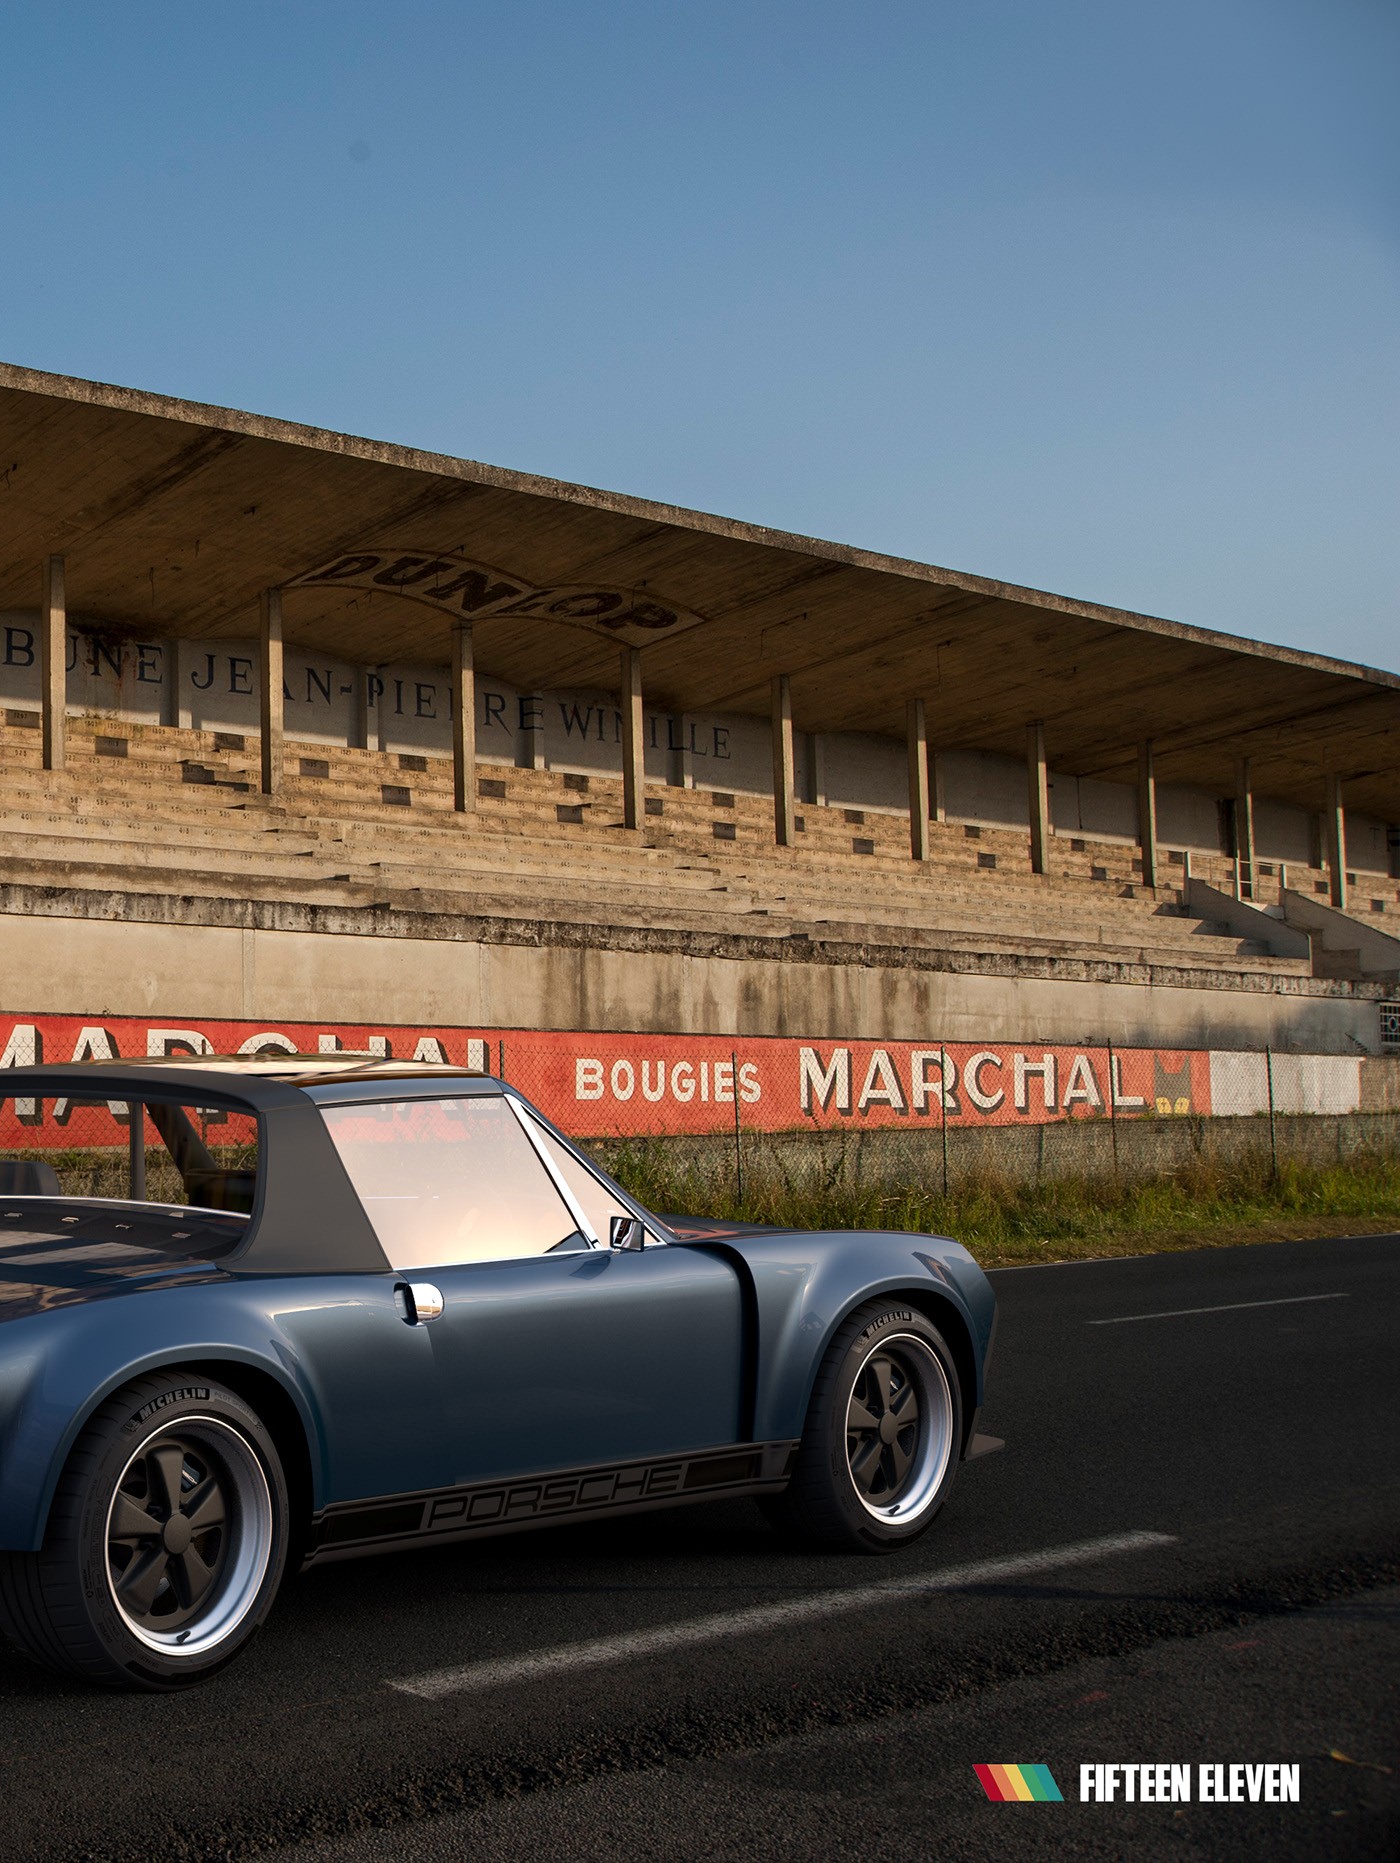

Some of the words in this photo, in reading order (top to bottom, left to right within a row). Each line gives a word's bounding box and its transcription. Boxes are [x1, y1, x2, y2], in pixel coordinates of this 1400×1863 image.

[302, 554, 679, 630] DUNLOP
[191, 653, 544, 737] JEN-PIERE
[576, 1058, 762, 1103] BOUGIES
[800, 1047, 1144, 1111] MARCHAL
[866, 1311, 910, 1335] MICHELIN
[140, 1387, 208, 1420] MICHELIN
[427, 1463, 683, 1530] PORSCHE
